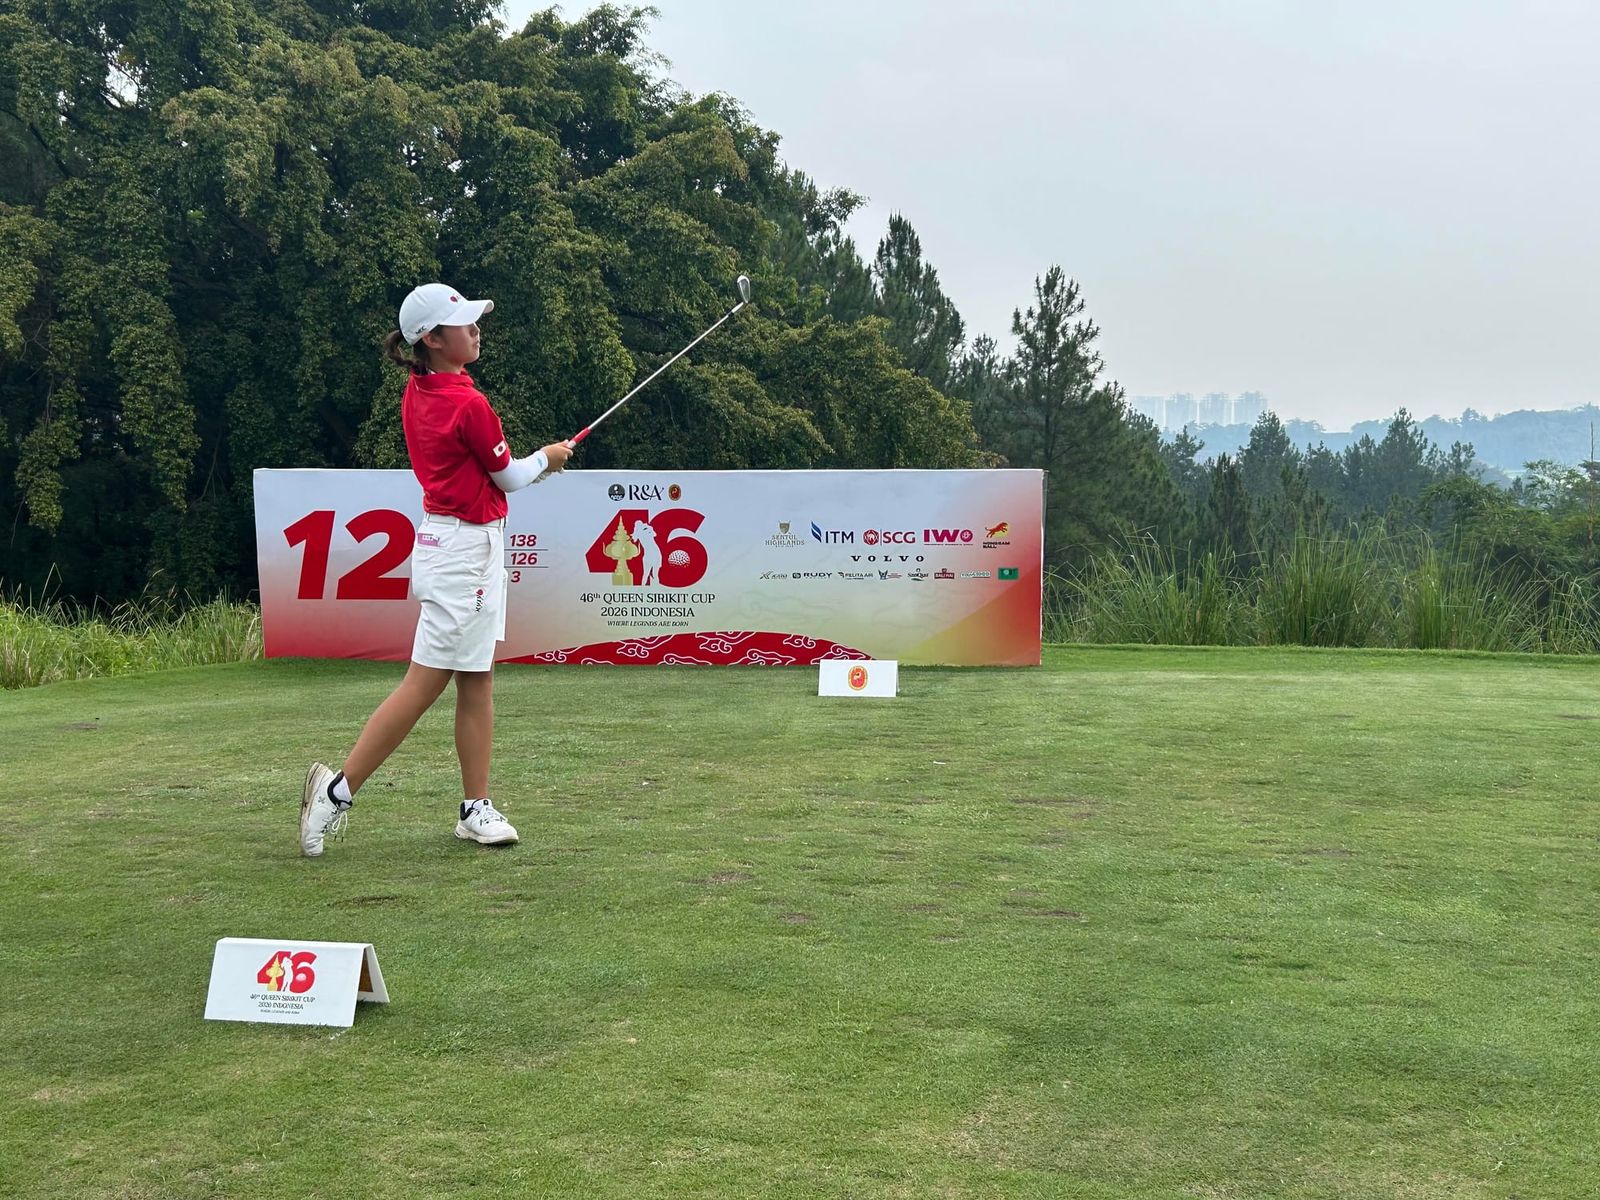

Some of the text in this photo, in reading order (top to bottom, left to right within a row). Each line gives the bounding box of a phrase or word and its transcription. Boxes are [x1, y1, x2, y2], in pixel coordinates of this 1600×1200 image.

[629, 484, 664, 501] R&A
[510, 534, 537, 547] 138
[825, 531, 854, 544] ITM
[882, 531, 916, 544] SCG
[923, 529, 974, 543] IWO
[283, 509, 416, 600] 12
[585, 508, 709, 588] 46
[510, 552, 538, 565] 126
[511, 571, 521, 583] 3
[580, 593, 716, 604] 46th QUEEN SIRIKIT CUP
[600, 607, 695, 617] 2026 INDONESIA
[257, 951, 317, 993] 46
